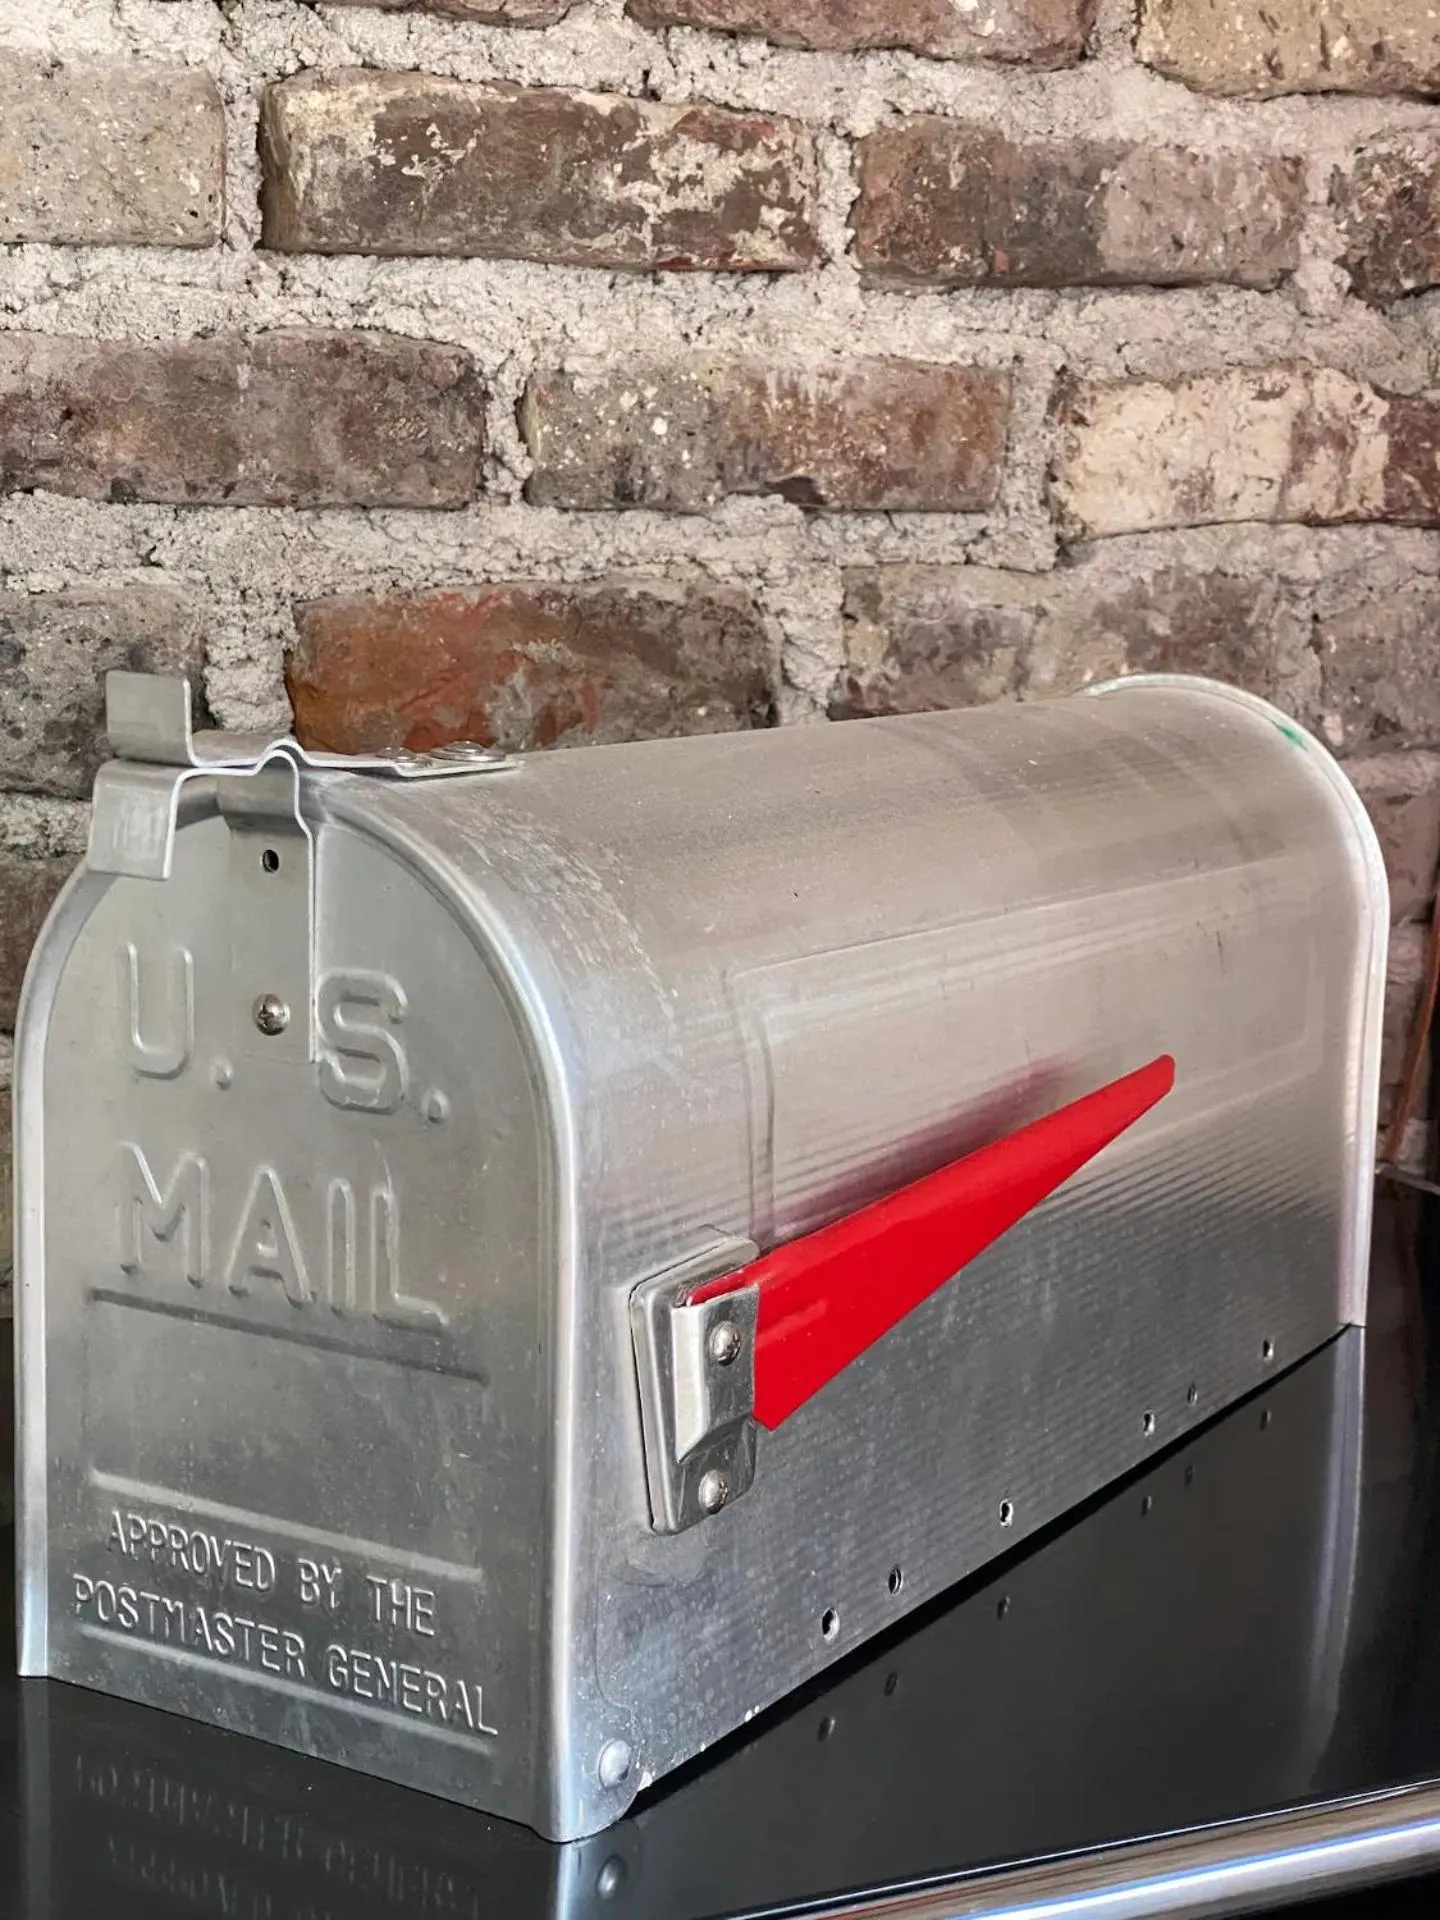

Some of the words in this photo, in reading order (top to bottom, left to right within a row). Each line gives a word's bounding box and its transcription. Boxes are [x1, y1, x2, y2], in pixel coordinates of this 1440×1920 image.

[115, 1140, 450, 1335] MAIL
[73, 1573, 306, 1679] POSTMASTER
[326, 1643, 499, 1736] GENERAL
[106, 1509, 277, 1592] APPROVED
[298, 1557, 343, 1610] BY
[366, 1573, 436, 1637] THE
